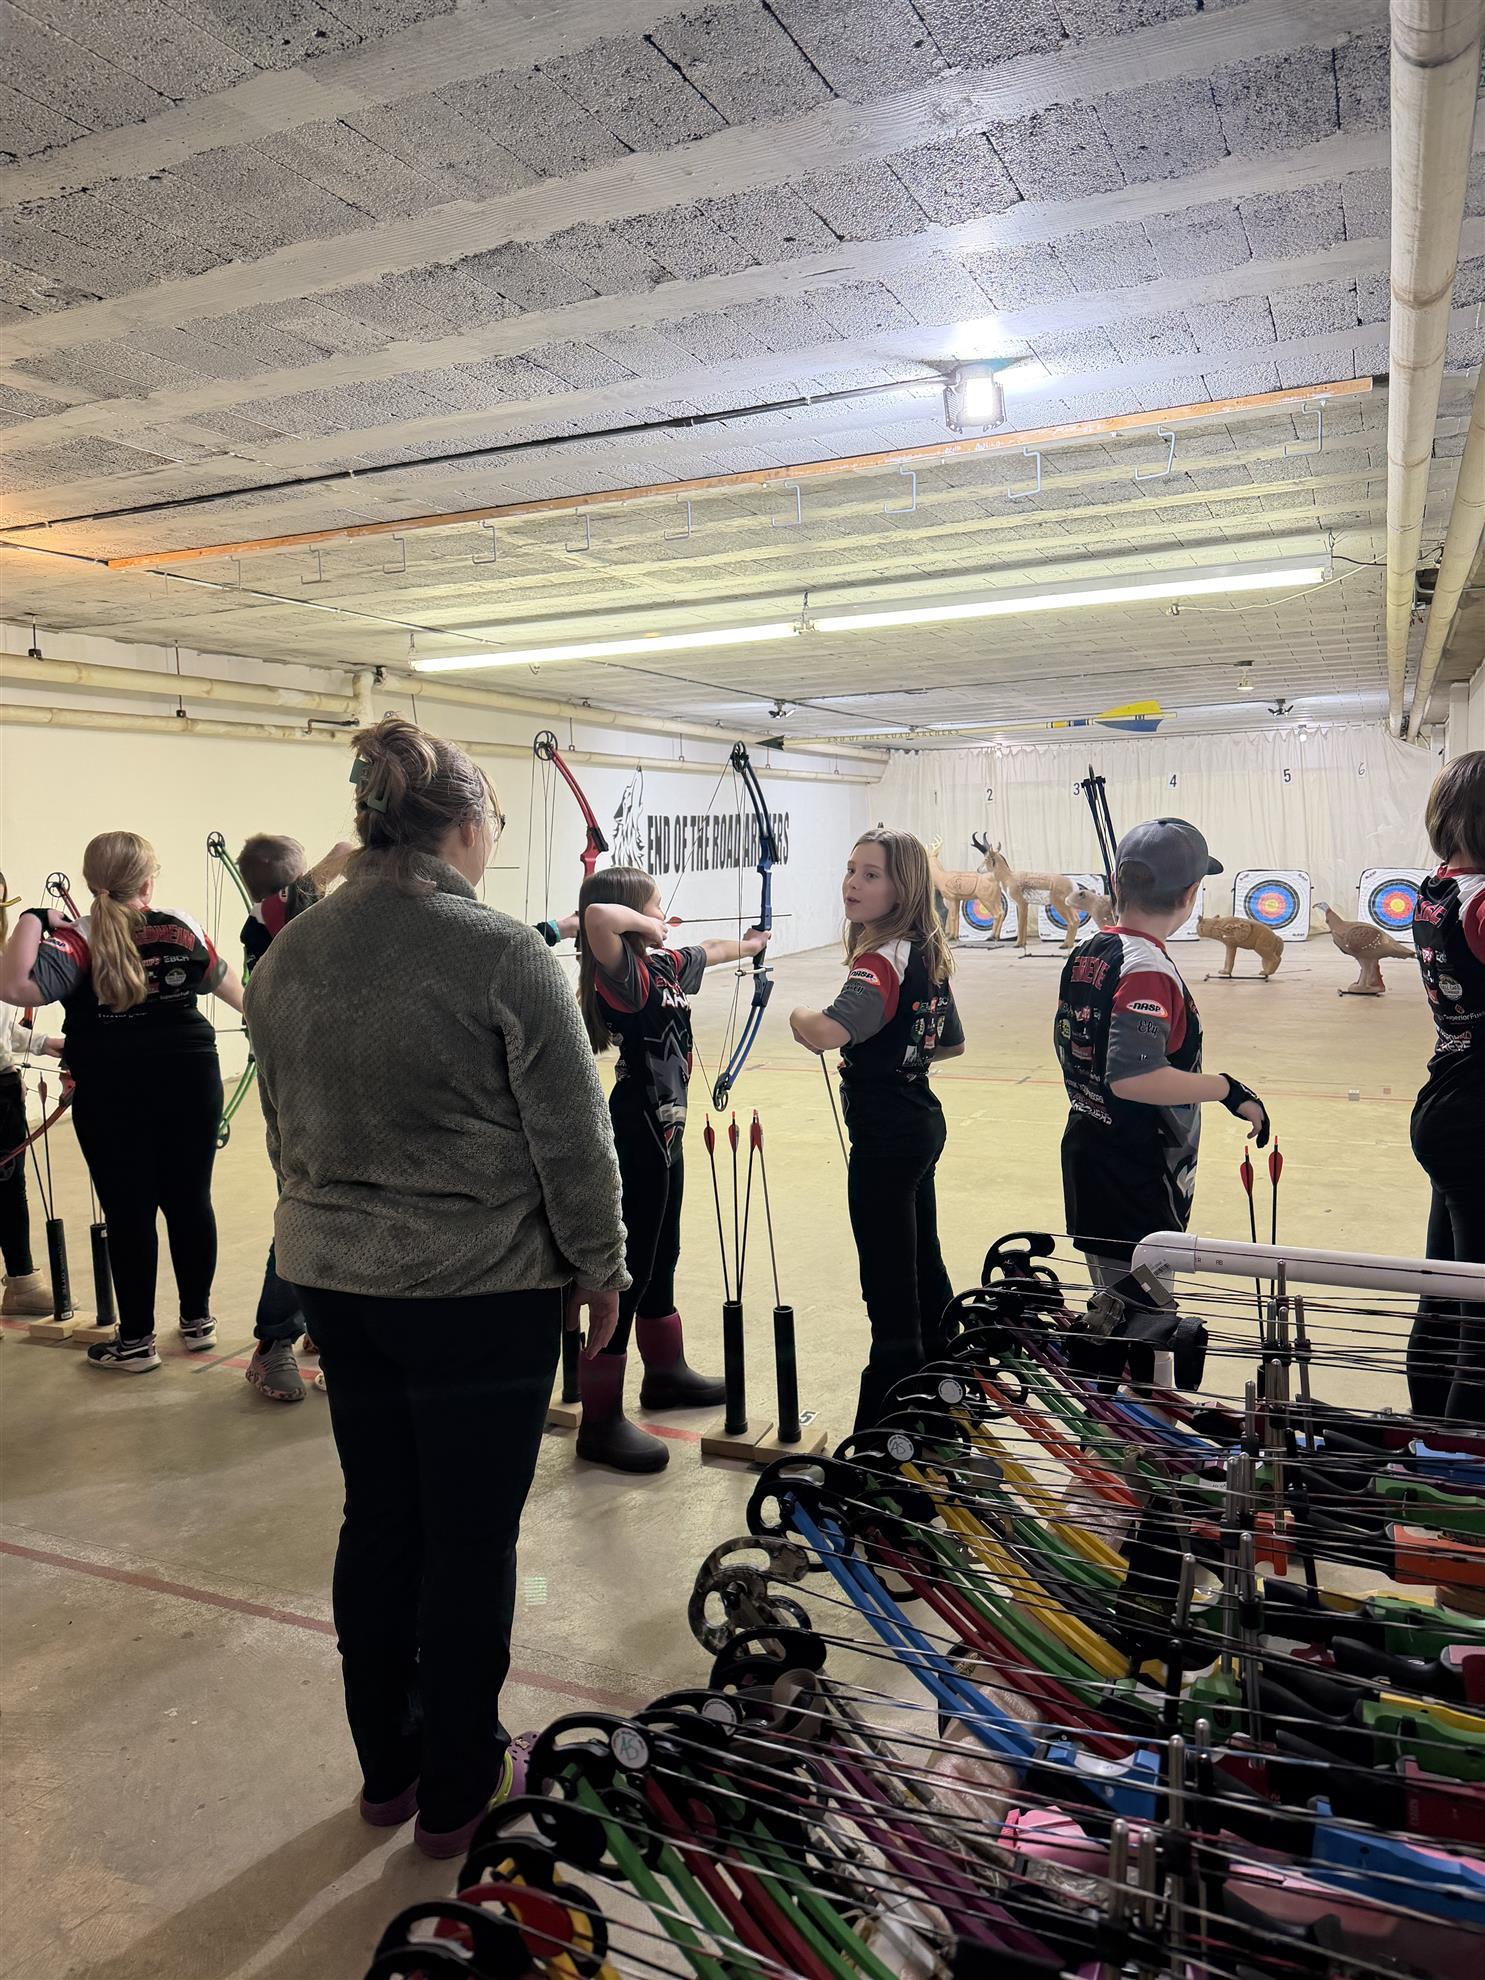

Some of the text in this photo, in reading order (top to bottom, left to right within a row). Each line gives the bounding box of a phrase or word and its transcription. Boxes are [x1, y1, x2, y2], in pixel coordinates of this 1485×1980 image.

[1283, 768, 1292, 783] 5
[1358, 762, 1366, 776] 6
[1169, 774, 1177, 787] 4
[986, 788, 993, 801] 2
[1073, 783, 1080, 796] 3
[648, 815, 670, 876] END
[674, 815, 687, 874] OF
[690, 815, 710, 872] THE
[712, 814, 740, 870] ROAD
[799, 1411, 816, 1423] 5
